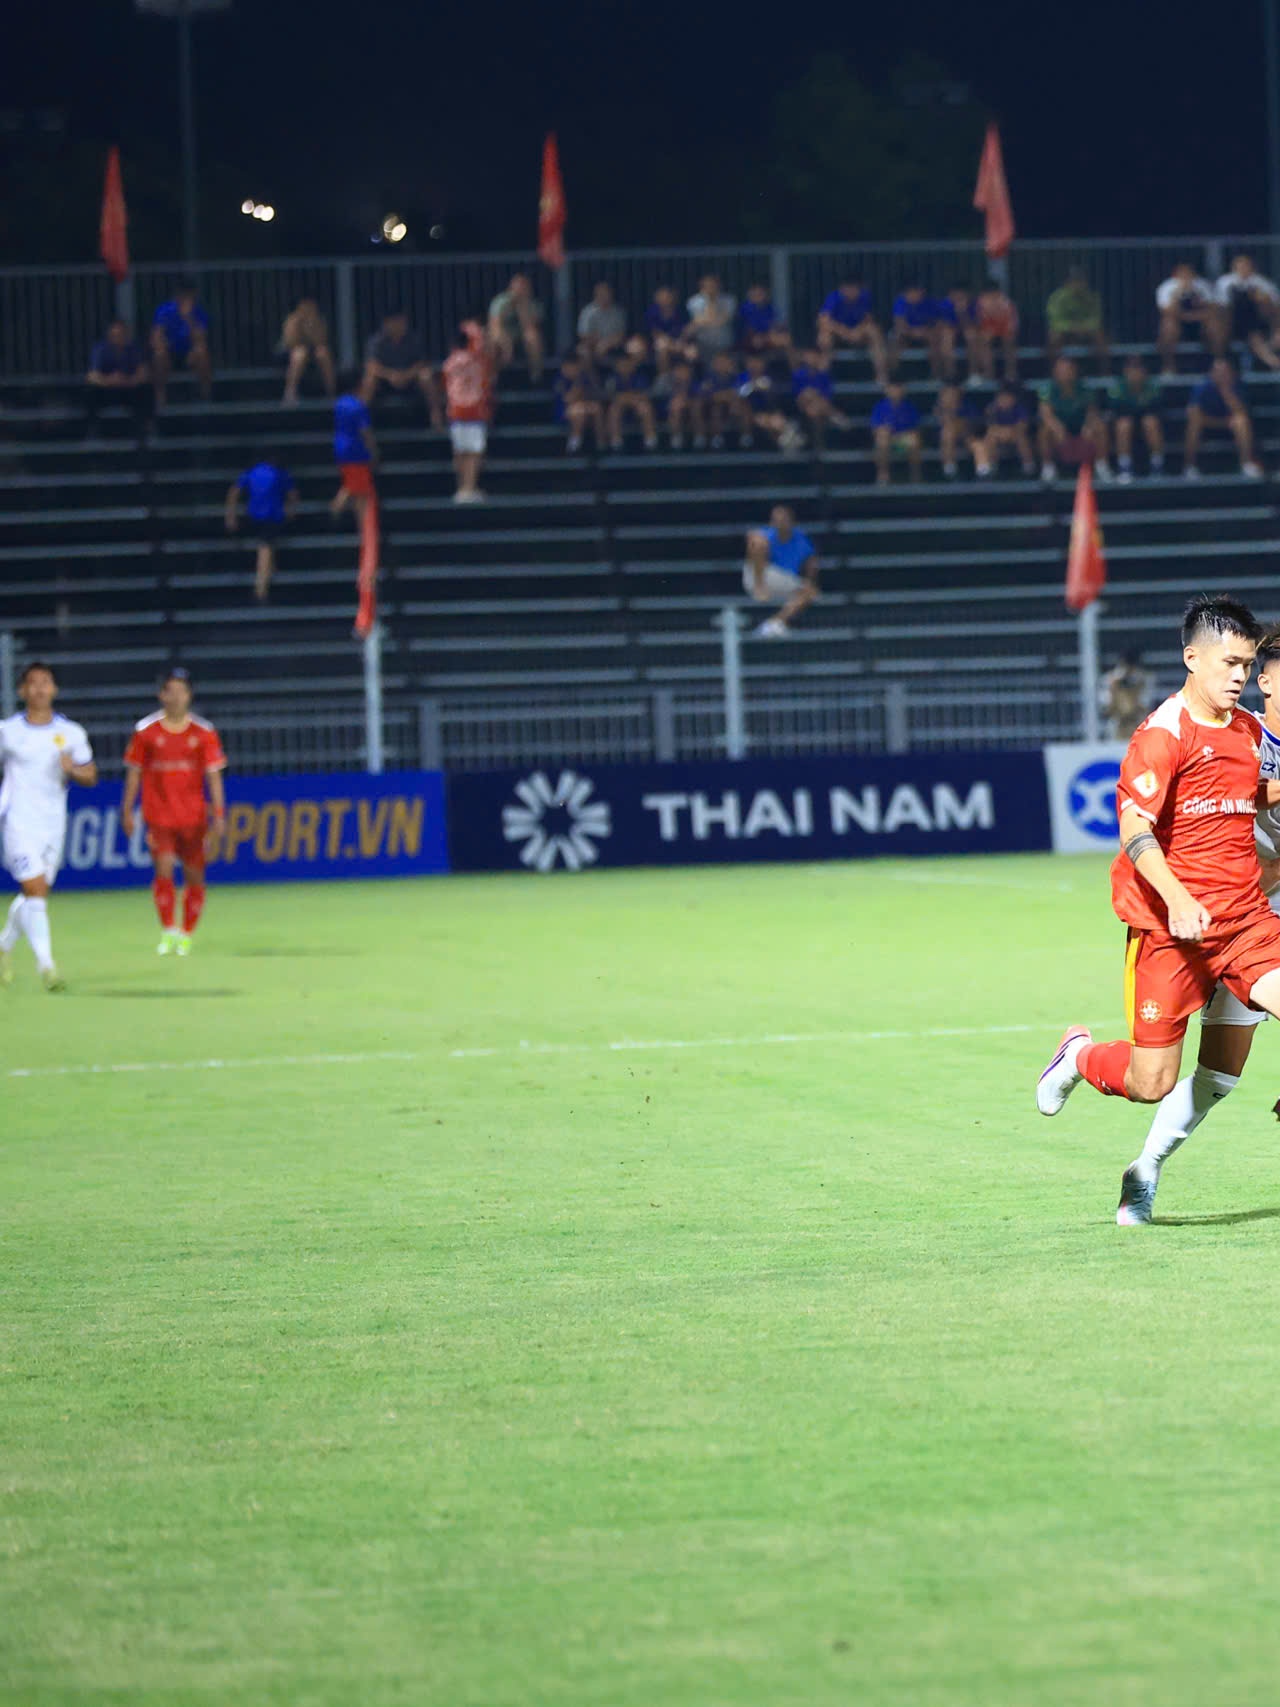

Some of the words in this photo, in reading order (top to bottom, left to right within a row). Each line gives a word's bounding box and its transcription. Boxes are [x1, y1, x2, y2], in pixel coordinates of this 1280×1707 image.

[642, 790, 813, 841] THAI
[828, 781, 994, 834] NAM
[1182, 796, 1217, 815] CÔNG
[1220, 799, 1235, 814] AN
